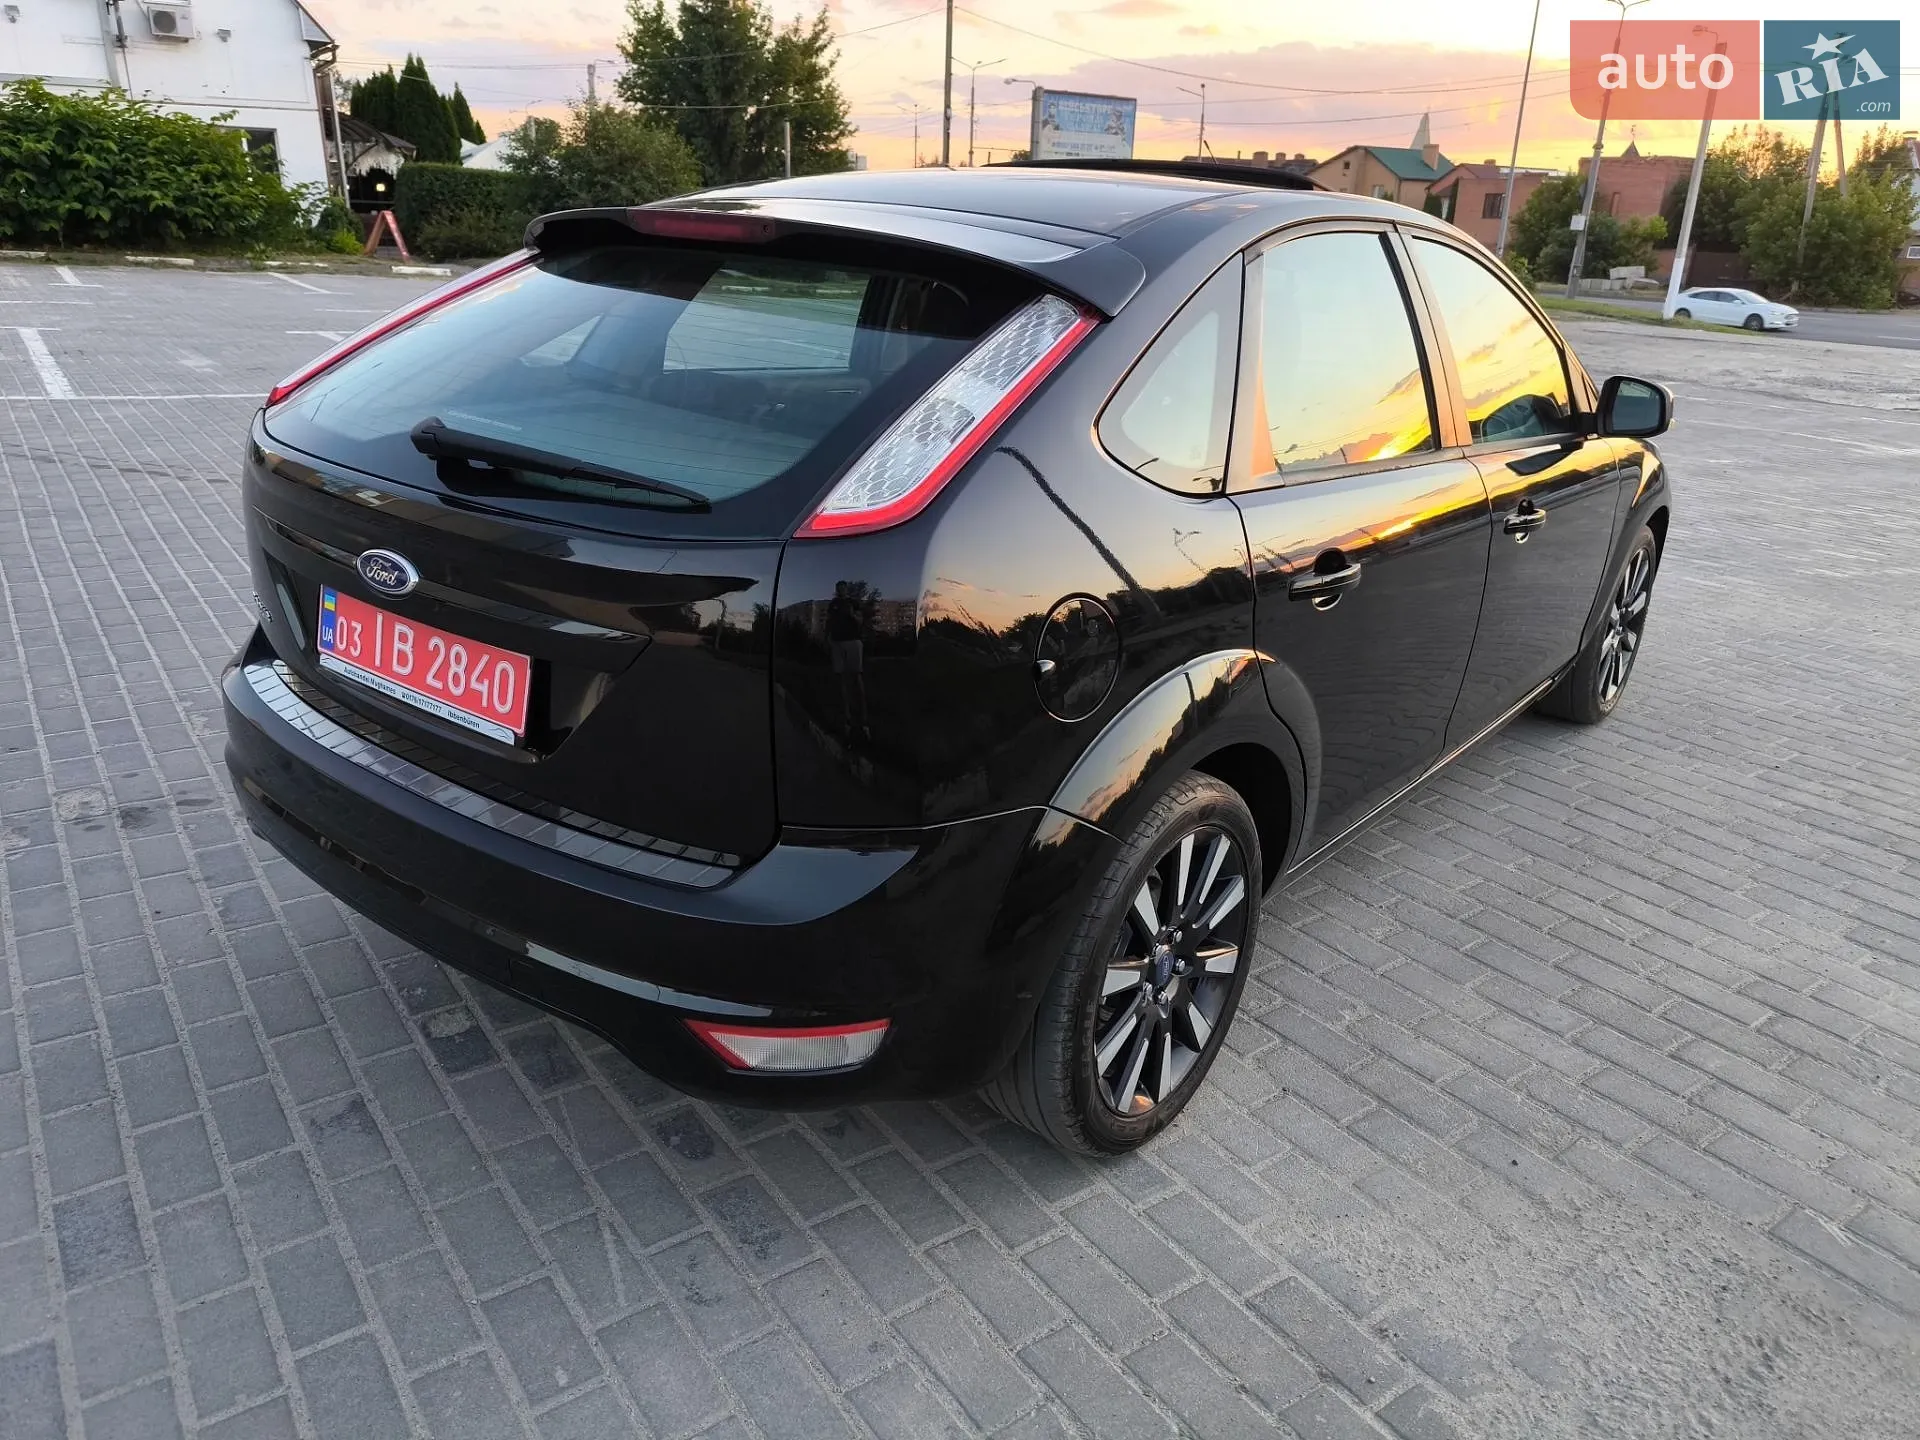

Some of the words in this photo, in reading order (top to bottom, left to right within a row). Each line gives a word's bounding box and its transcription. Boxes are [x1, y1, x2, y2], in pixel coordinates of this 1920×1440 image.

[366, 557, 399, 586] Ford
[322, 625, 334, 644] UA
[336, 615, 362, 658] 03
[426, 635, 515, 714] 2840
